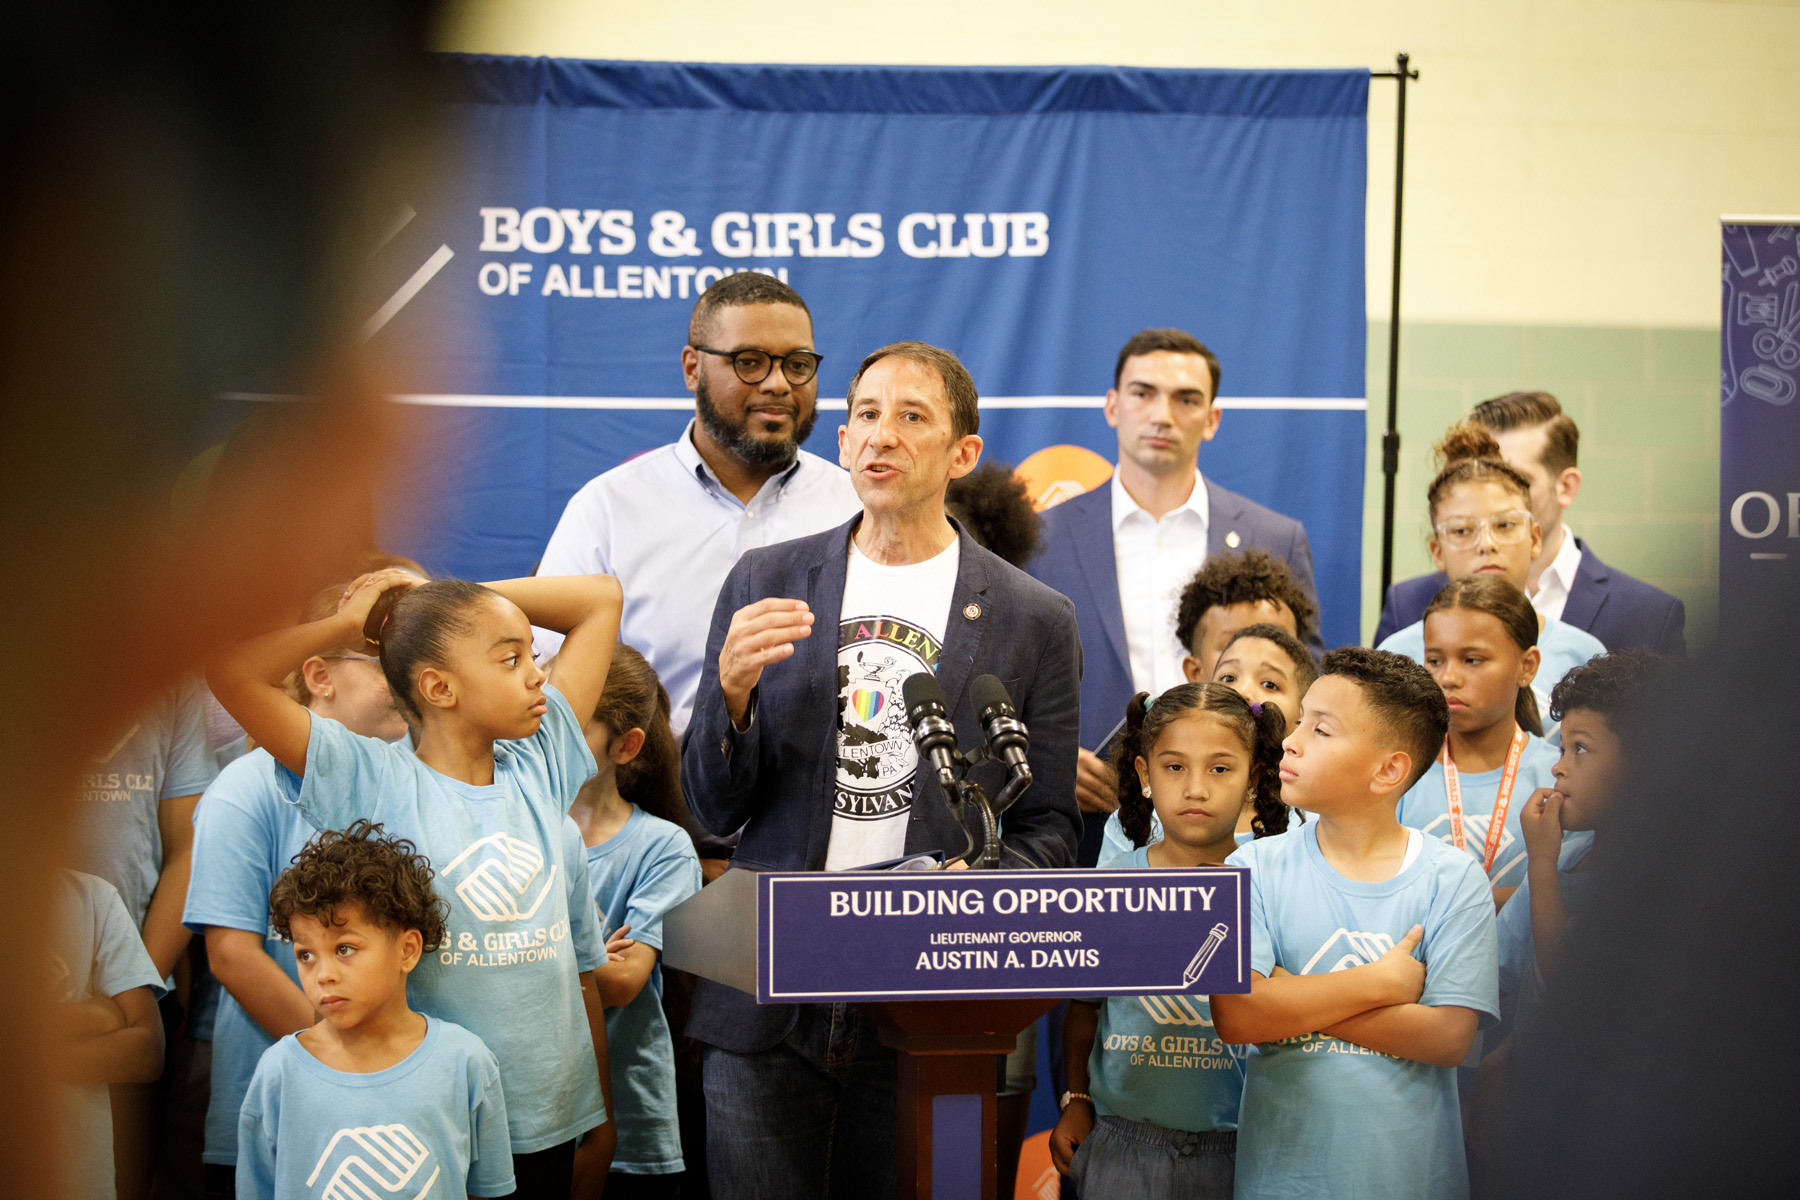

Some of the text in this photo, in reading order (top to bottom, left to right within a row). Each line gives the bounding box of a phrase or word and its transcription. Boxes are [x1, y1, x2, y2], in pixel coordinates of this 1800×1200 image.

[479, 206, 1050, 258] BOYS & GIRLS CLUB
[478, 261, 533, 296] OF
[882, 765, 897, 777] PA
[1491, 808, 1504, 834] CLASS
[829, 886, 1217, 917] BUILDING OPPORTUNITY
[457, 931, 479, 952] &
[484, 927, 548, 952] GIRLS
[930, 931, 1083, 945] LIEUTENANT GOVERNOR
[440, 945, 558, 966] OF ALLENTOWN
[915, 948, 1101, 970] AUSTIN A. DAVIS
[1141, 1034, 1157, 1053] &
[1160, 1035, 1224, 1056] GIRLS
[1302, 1041, 1324, 1054] OF
[1130, 1053, 1233, 1070] OF ALLENTOWN
